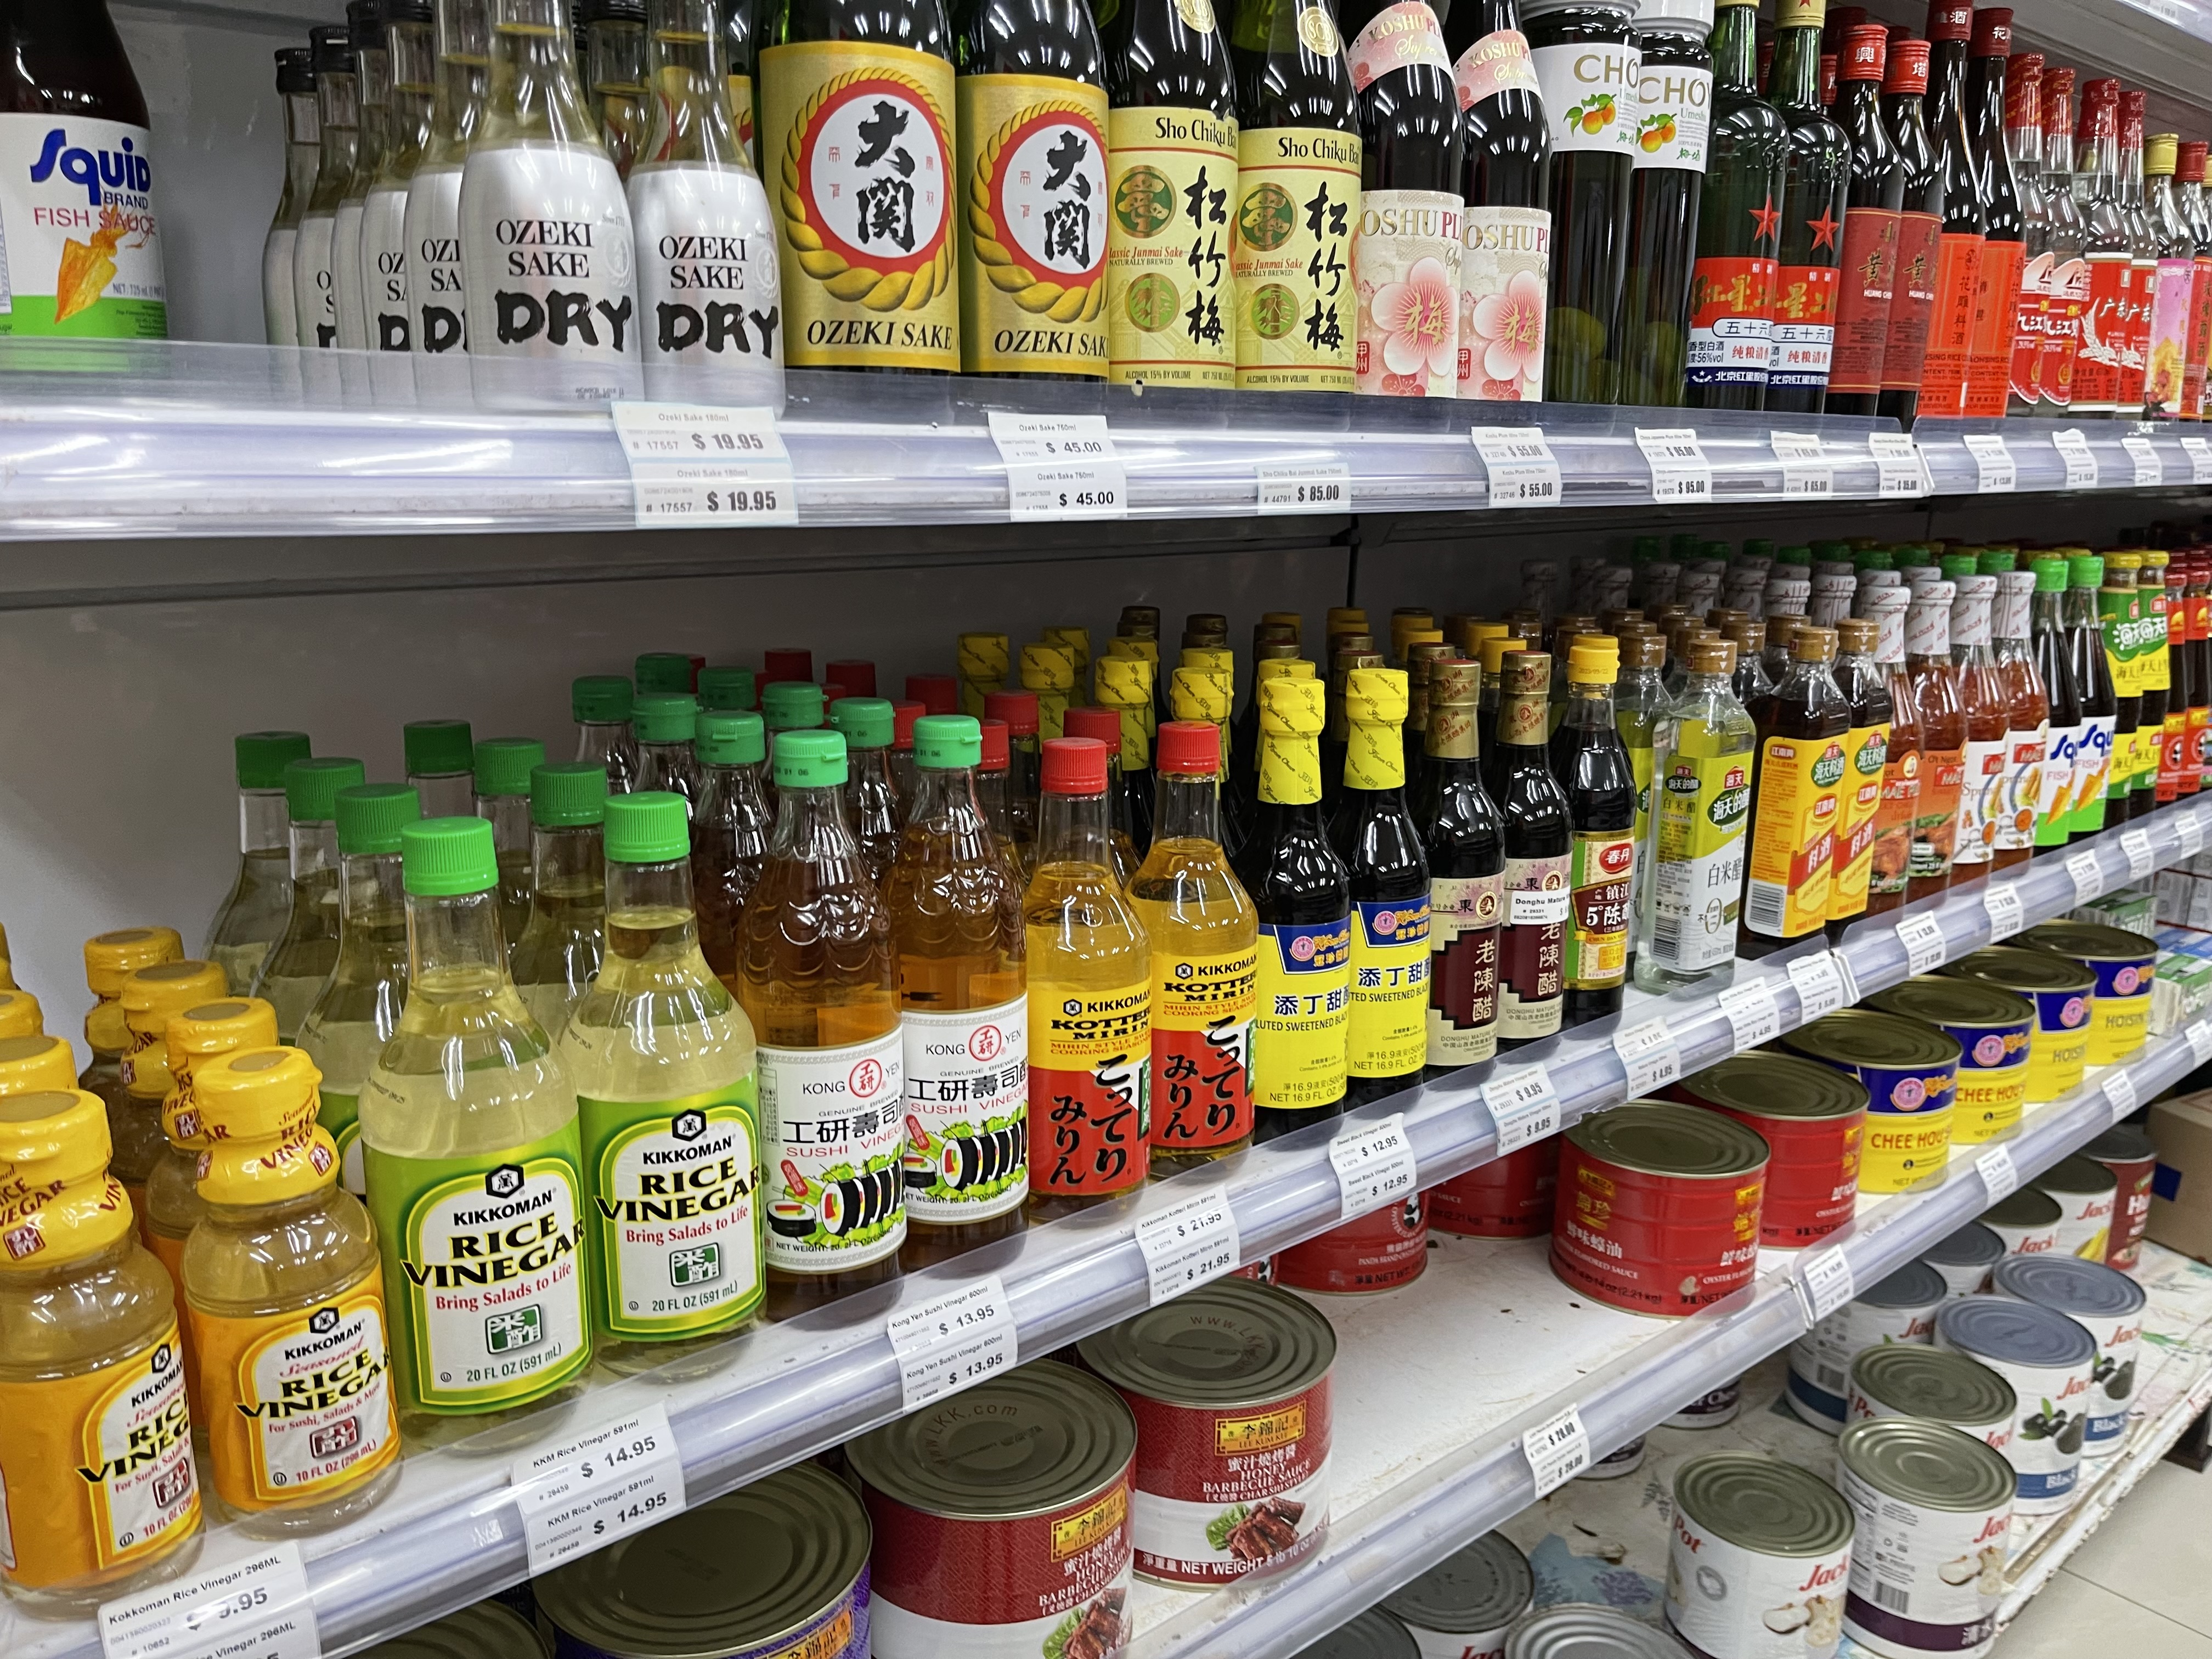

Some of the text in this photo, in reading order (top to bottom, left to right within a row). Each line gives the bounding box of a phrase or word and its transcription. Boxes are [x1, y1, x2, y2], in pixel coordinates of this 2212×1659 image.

[1368, 16, 1425, 43] KOSHU
[1471, 43, 1522, 69] KOSHU
[104, 191, 148, 210] BRAND
[33, 208, 155, 235] FISH SAUCE
[496, 219, 594, 247] OZEKI
[659, 235, 748, 262] OZEKI
[1183, 165, 1227, 347] 松竹梅
[508, 251, 590, 278] SAKE
[670, 266, 744, 290] SAKE
[1304, 180, 1348, 353] 松竹梅
[494, 289, 632, 353] DRY
[657, 300, 778, 359] DRY
[807, 320, 953, 350] OZEKI SAKE
[1404, 291, 1446, 353] 梅
[1246, 375, 1269, 384] ALCOHOL
[1290, 375, 1310, 383] VOLUME
[691, 433, 764, 451] $ 19.95
[1045, 442, 1102, 454] $ 45.00
[707, 490, 777, 512] $ 19.95
[1059, 491, 1114, 507] $ 45.00
[1297, 484, 1339, 503] $ 85.00
[1520, 482, 1553, 499] $ 55.00
[1678, 482, 1683, 494] $
[1515, 898, 1545, 906] Donghu
[1184, 984, 1255, 1002] MIRIN
[1472, 939, 1496, 1023] 老陳醋
[1205, 999, 1238, 1009] STYLE
[926, 1029, 1023, 1056] KONG YEN
[1050, 1035, 1131, 1050] MIRIN STYLE
[1073, 1018, 1149, 1040] MIRIN
[802, 1061, 900, 1096] KONG YEN
[940, 1056, 1020, 1077] GENUINE BREWED
[1201, 1015, 1241, 1137] こってり
[819, 1090, 899, 1117] GENUINE BREWED
[1163, 1054, 1199, 1139] みりん
[1955, 1086, 1992, 1103] CHEE
[642, 1138, 733, 1166] KIKKOMAN
[1049, 1095, 1087, 1185] みりん
[1361, 1135, 1398, 1157] $ 12.95
[1871, 1132, 1912, 1149] CHEE
[639, 1156, 737, 1196] RICE
[1372, 1173, 1408, 1196] $ 12.95
[453, 1189, 554, 1227] KIKKOMAN
[594, 1163, 761, 1223] VINEGAR
[449, 1210, 558, 1260] RICE
[626, 1204, 749, 1246] Bring Salads to Life
[1177, 1213, 1222, 1237] $ 21.95
[399, 1217, 585, 1289] VINEGAR
[1187, 1252, 1230, 1280] $ 21.95
[435, 1262, 572, 1312] Bring Salads to Life
[652, 1279, 738, 1312] 20 FL OZ (591 mL)
[891, 1285, 989, 1329] Kong Yen Sushi Vinegar 600ml
[939, 1322, 949, 1336] $
[956, 1304, 995, 1328] 13.95
[284, 1324, 362, 1362] KIKKOMAN
[280, 1348, 371, 1399] RICE
[466, 1340, 562, 1383] 20 FL OZ (591 mL)
[949, 1353, 1003, 1385] $ 13.95
[237, 1347, 392, 1420] VINEGAR
[533, 1419, 640, 1468] KKM Rice Vinegar 591ml
[580, 1435, 656, 1479] $ 14.95
[1203, 1457, 1311, 1493] BARBECUE SAUCE
[1240, 1461, 1287, 1481] HONEY
[548, 1475, 654, 1528] KKM Rice Vinegar 591ml
[593, 1492, 668, 1534] $ 14.95
[109, 1555, 281, 1626] Kokkoman Rice Vinegar 296ML
[215, 1621, 296, 1658] Vinegar 296ML
